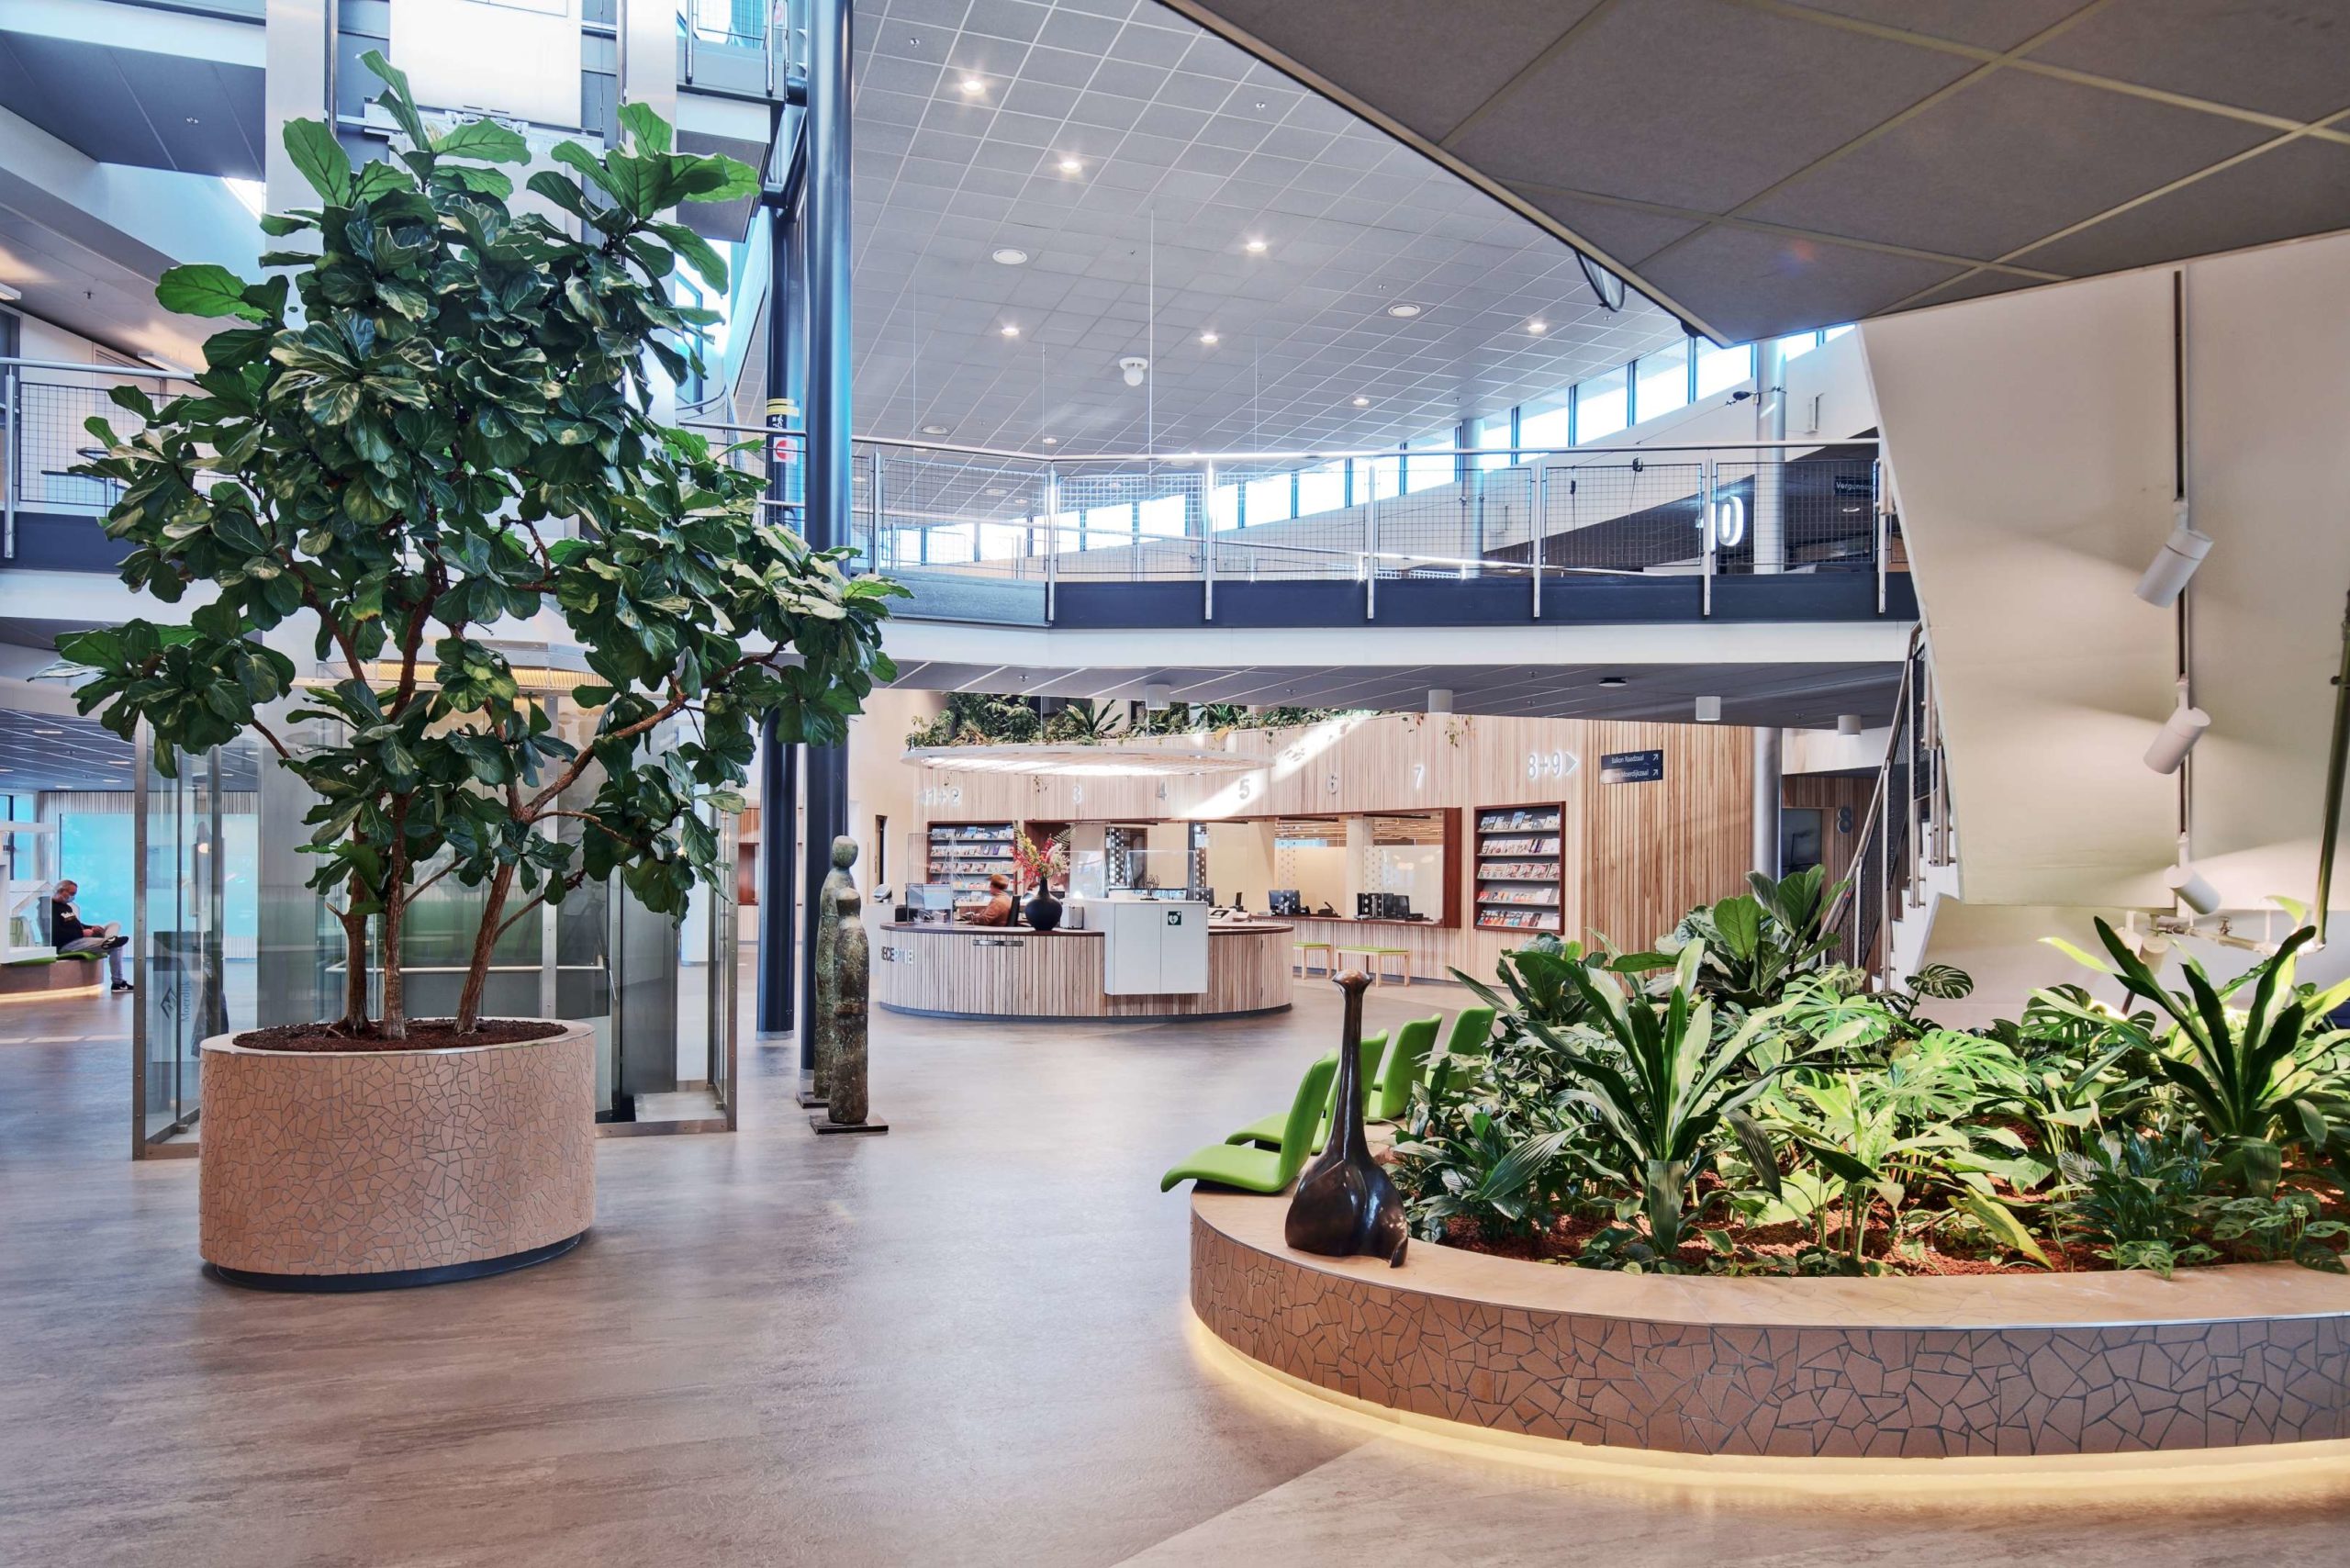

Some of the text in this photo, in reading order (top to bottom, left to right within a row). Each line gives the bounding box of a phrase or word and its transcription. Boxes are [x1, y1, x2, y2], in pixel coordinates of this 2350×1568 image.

[1413, 764, 1424, 790] 7
[1528, 752, 1562, 779] 8+9
[1072, 785, 1081, 803] 3
[1156, 781, 1167, 801] 4
[1238, 778, 1250, 800] 5
[181, 980, 191, 1022] Moerdijk
